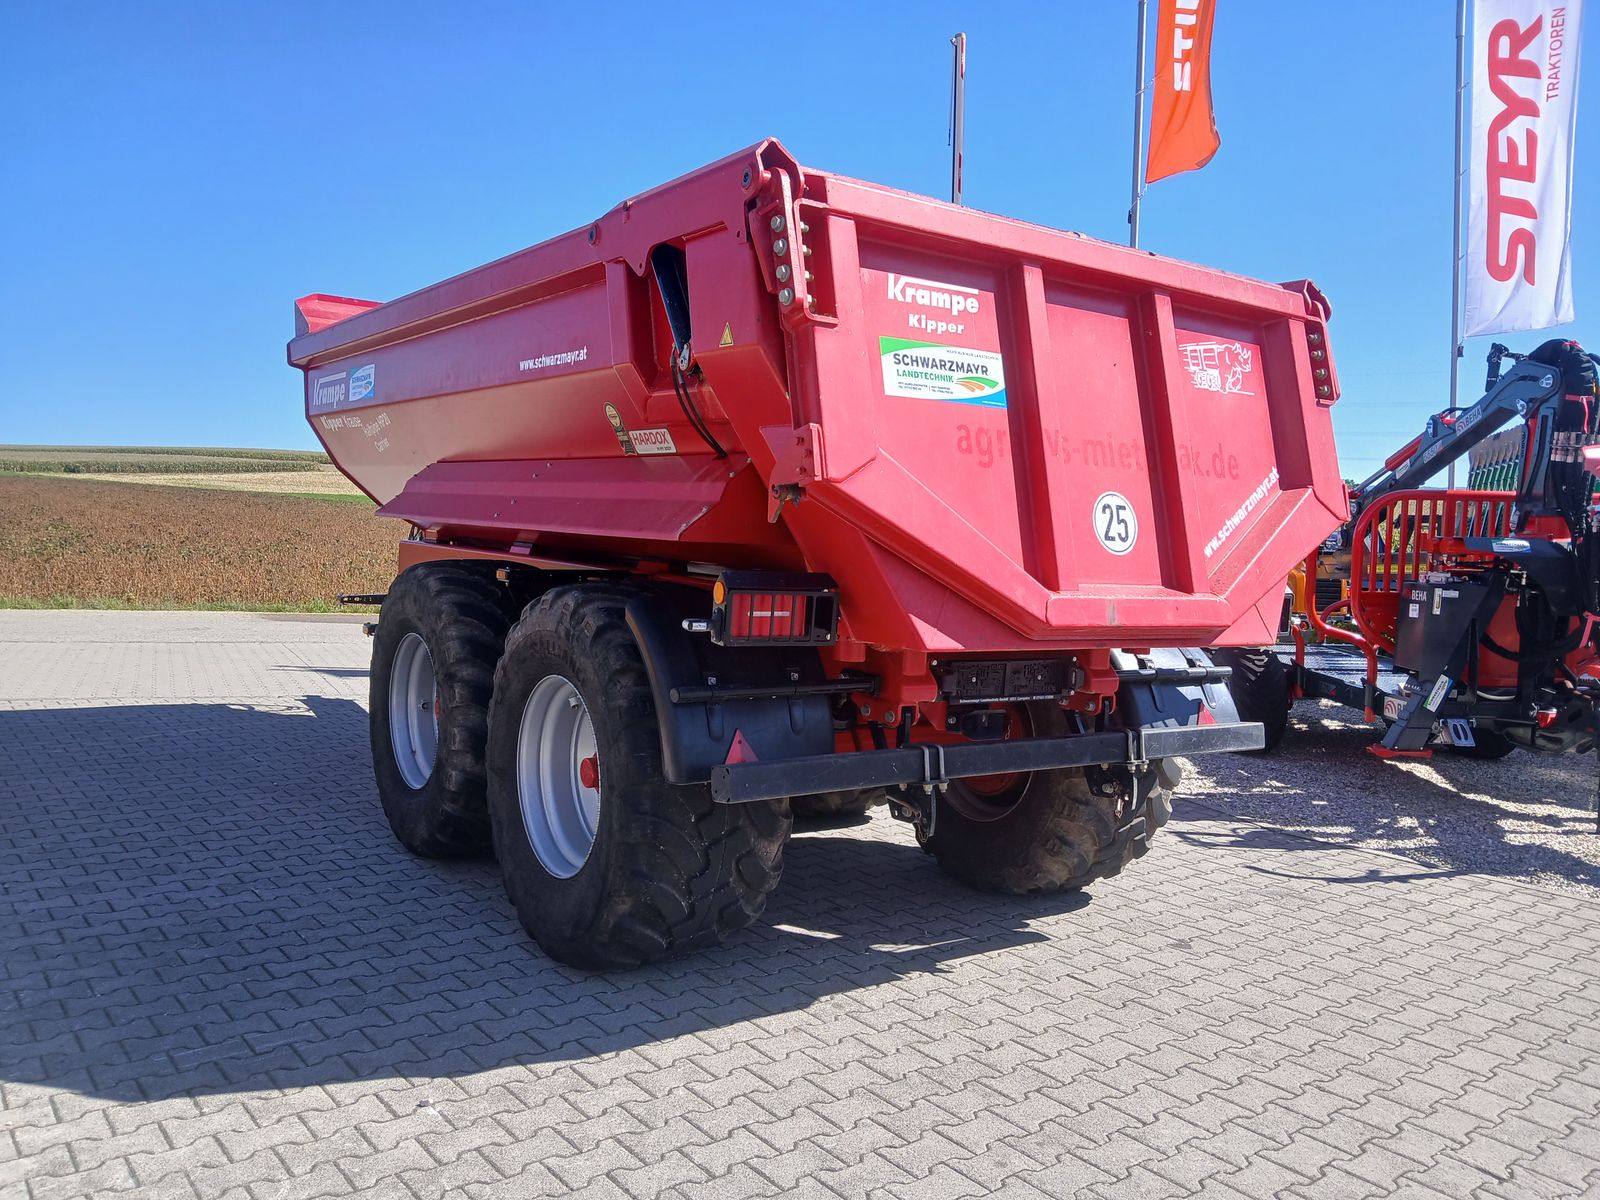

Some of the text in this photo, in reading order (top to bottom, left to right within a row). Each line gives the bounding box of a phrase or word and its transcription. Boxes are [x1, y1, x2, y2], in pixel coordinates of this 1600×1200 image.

[1546, 7, 1566, 102] TRAKTOREN
[1486, 14, 1543, 286] STEYR
[887, 272, 979, 316] Krampe
[908, 313, 965, 334] Kipper
[519, 345, 588, 371] www.schwarzmayr.at
[893, 352, 989, 376] SCHWARZMAYR
[313, 371, 347, 409] Krampe
[896, 368, 955, 383] LANDTECHNIK
[631, 430, 670, 446] HARDOX
[1102, 503, 1129, 543] 25
[1203, 466, 1280, 558] ww.schwarzmayr.at
[1411, 589, 1428, 602] BEHA
